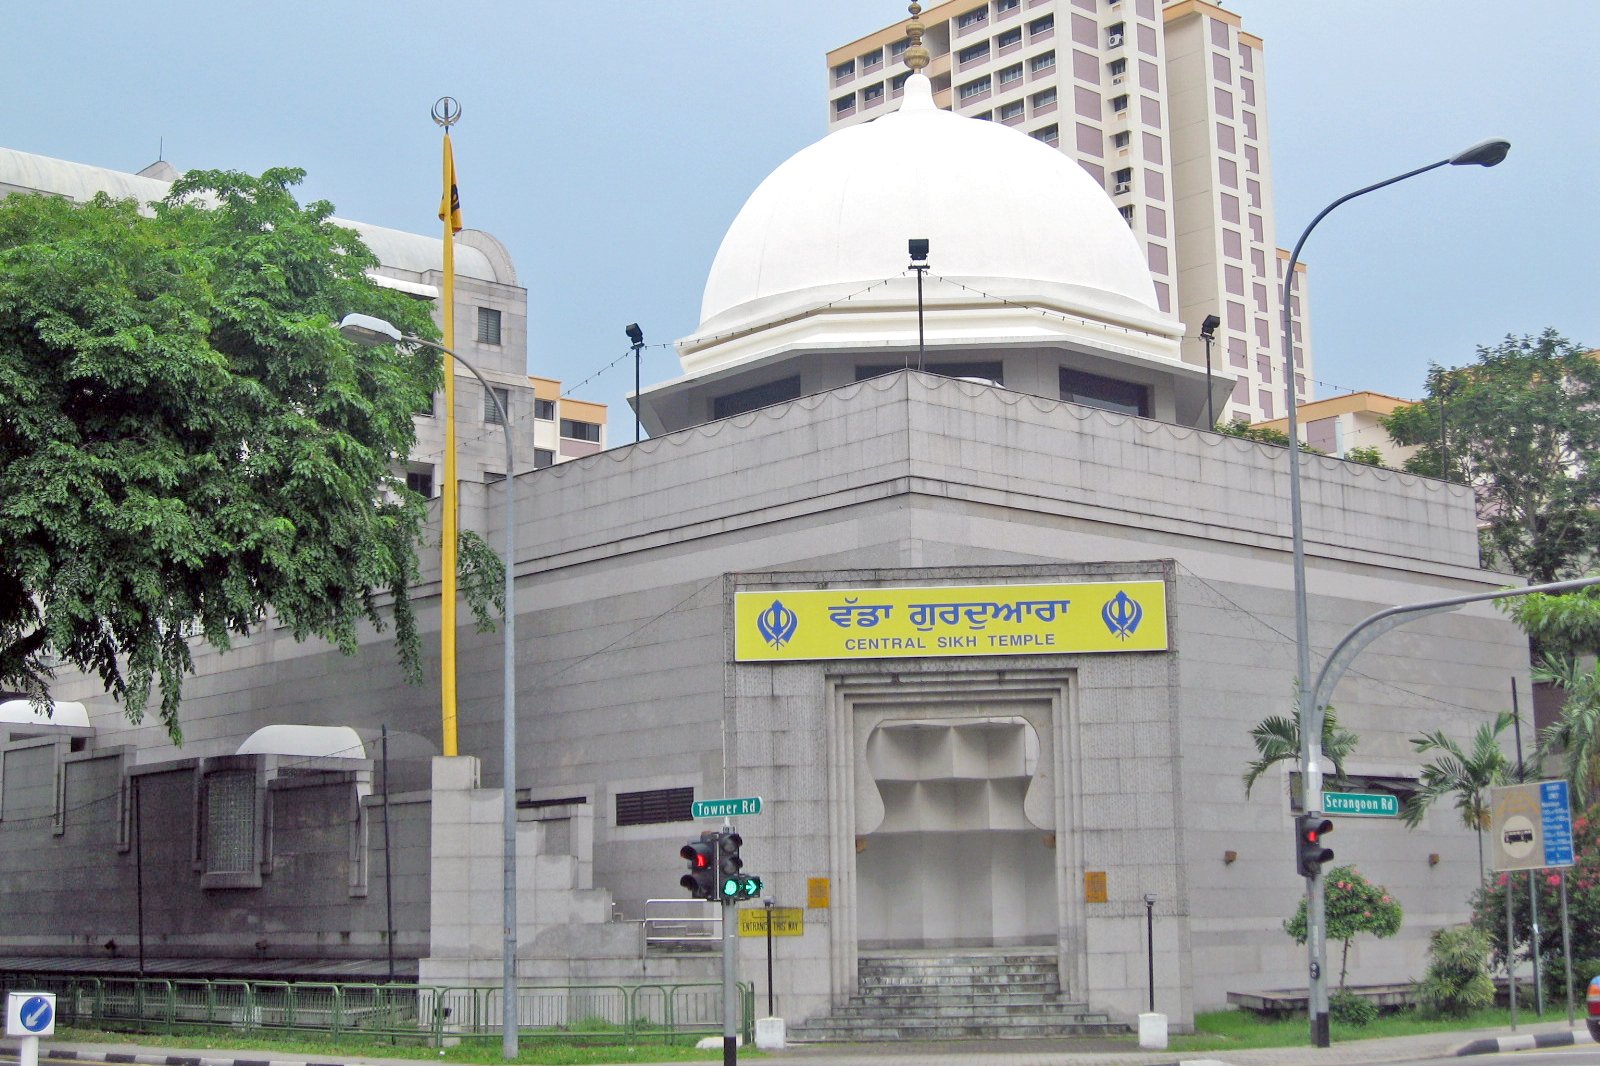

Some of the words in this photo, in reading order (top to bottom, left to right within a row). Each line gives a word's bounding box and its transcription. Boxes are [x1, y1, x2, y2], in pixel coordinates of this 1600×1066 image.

[828, 597, 893, 628] ਵੱਡਾ
[908, 600, 1070, 632] ਗੁਰਦੁਆਰਾ
[845, 637, 926, 650] CENTRAL
[937, 636, 977, 648] SIKH
[987, 634, 1055, 647] TEMPLE
[697, 803, 737, 816] Towner
[742, 800, 756, 813] Rd
[1325, 794, 1378, 812] Serangoon
[1381, 798, 1393, 810] Rd
[742, 921, 768, 932] ENTRANC
[773, 921, 786, 931] THIS
[788, 921, 799, 931] WAY
